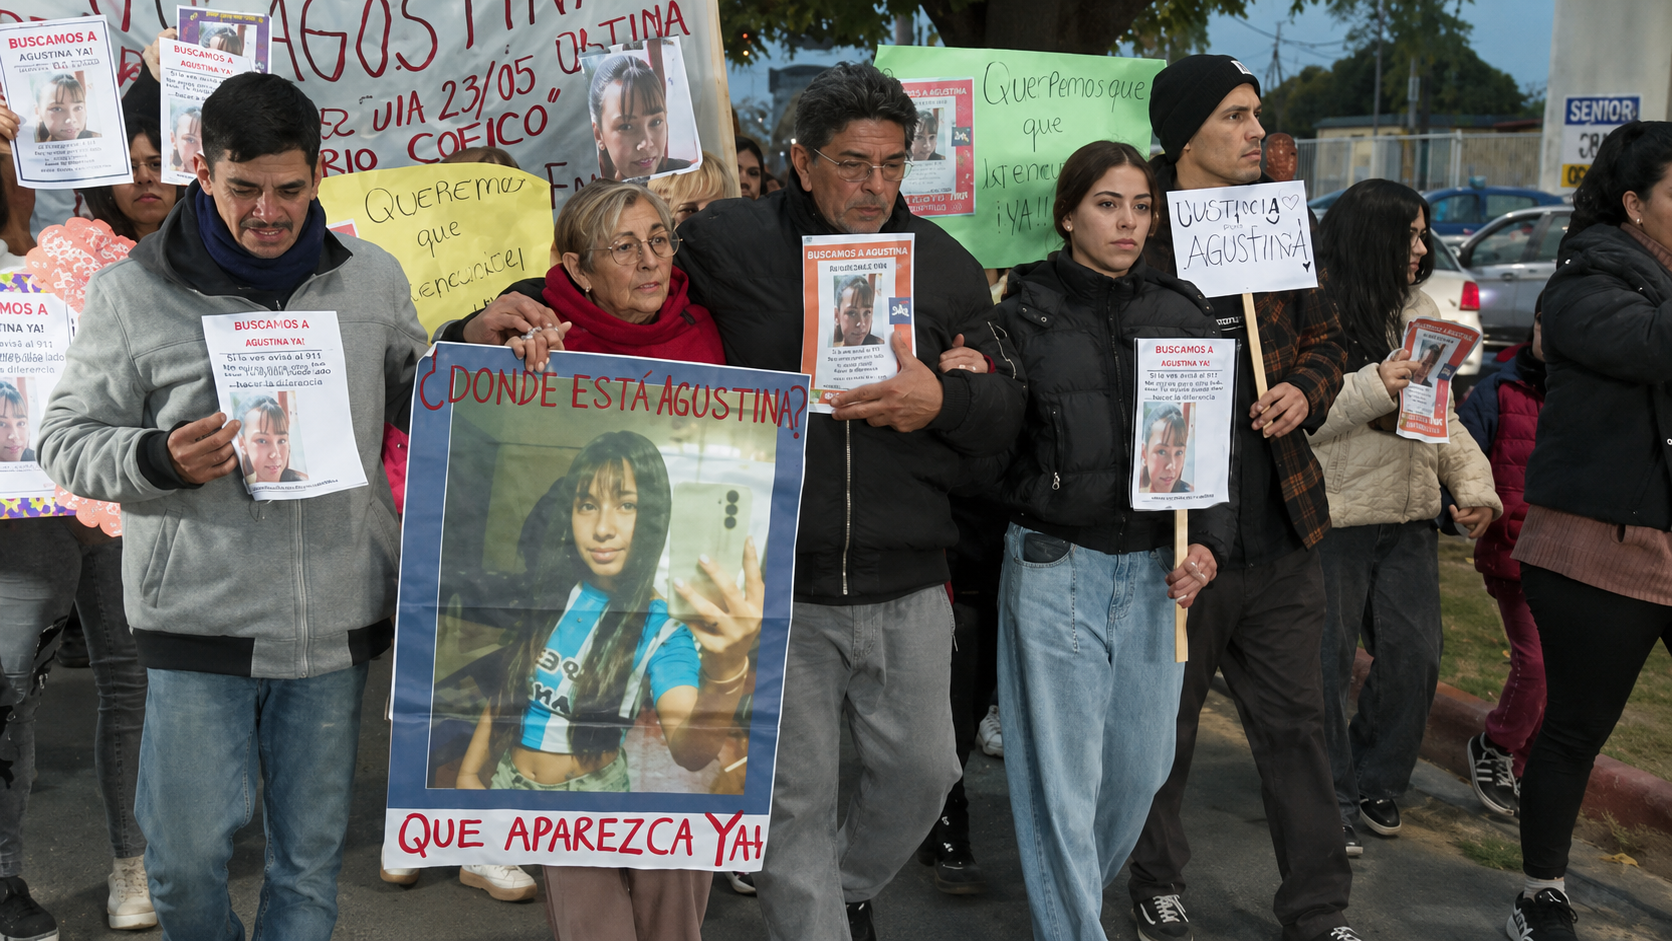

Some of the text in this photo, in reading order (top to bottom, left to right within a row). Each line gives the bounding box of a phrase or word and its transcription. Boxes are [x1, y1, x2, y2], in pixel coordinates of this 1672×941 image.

[8, 31, 97, 49] BUSCAMOS A
[19, 50, 72, 61] AGUSTINA
[174, 45, 225, 62] BUSCAMOS
[438, 55, 536, 121] 23/05
[1108, 79, 1145, 113] que
[1569, 100, 1633, 122] SENIOR
[1023, 117, 1063, 152] que
[417, 221, 461, 258] que
[807, 249, 856, 260] BUSCAMOS
[858, 249, 864, 257] A
[38, 303, 48, 315] A
[26, 324, 44, 333] YA!
[234, 319, 310, 331] BUSCAMOS A
[245, 338, 289, 347] AGUSTINA
[1155, 346, 1214, 354] BUSCAMOS A
[420, 349, 807, 439] ¿DONDE ESTÁ AGUSTINA?
[398, 812, 485, 859] QUE
[504, 816, 694, 856] APAREZCA
